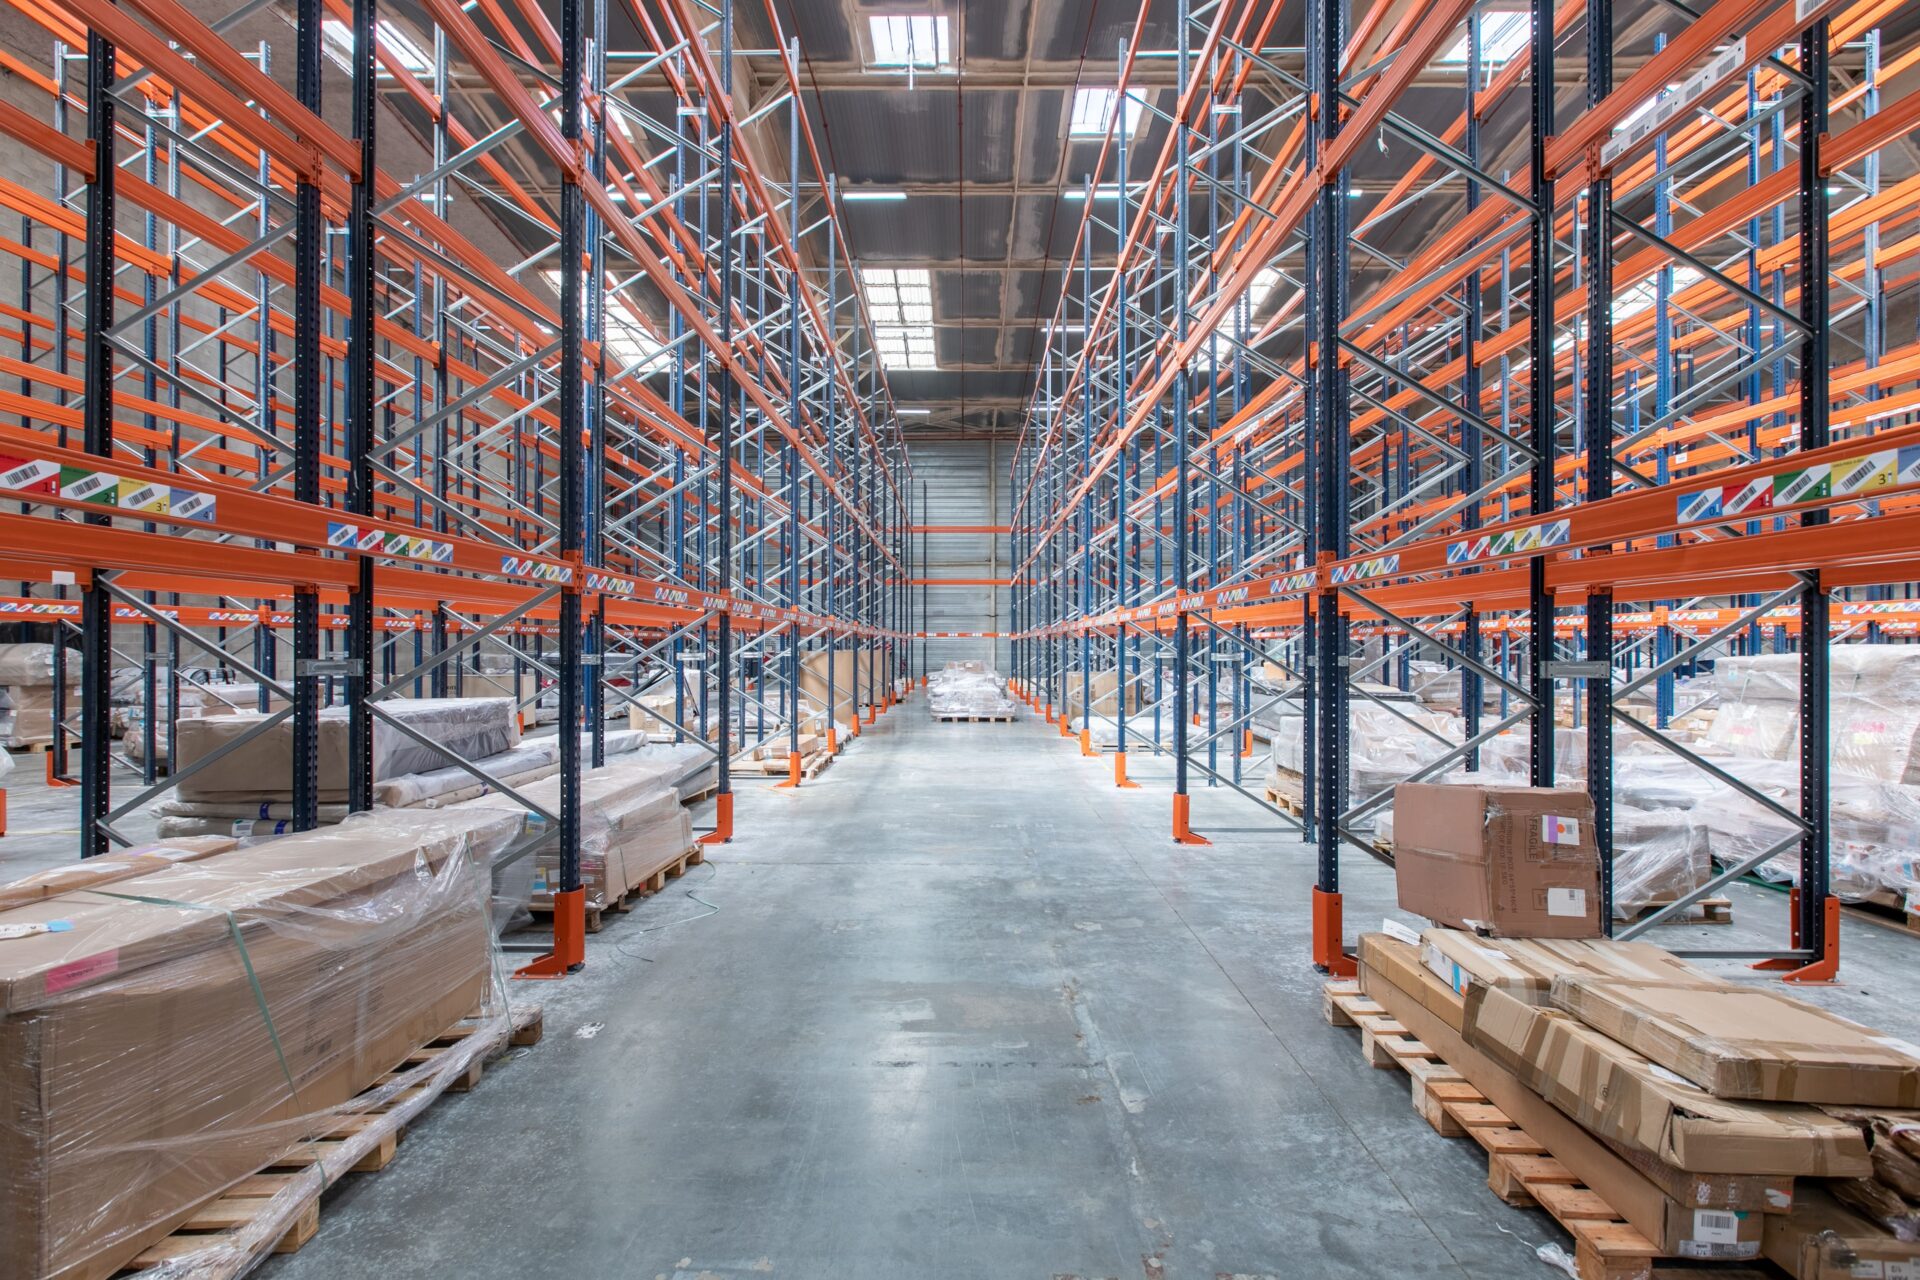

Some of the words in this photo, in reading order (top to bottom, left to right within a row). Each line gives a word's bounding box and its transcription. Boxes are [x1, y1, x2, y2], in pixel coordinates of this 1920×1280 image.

[1878, 473, 1886, 485] 3
[42, 481, 50, 493] 1
[1814, 486, 1821, 497] 2
[103, 492, 110, 503] 2
[156, 502, 162, 512] 3
[1528, 817, 1538, 860] FRAGILE
